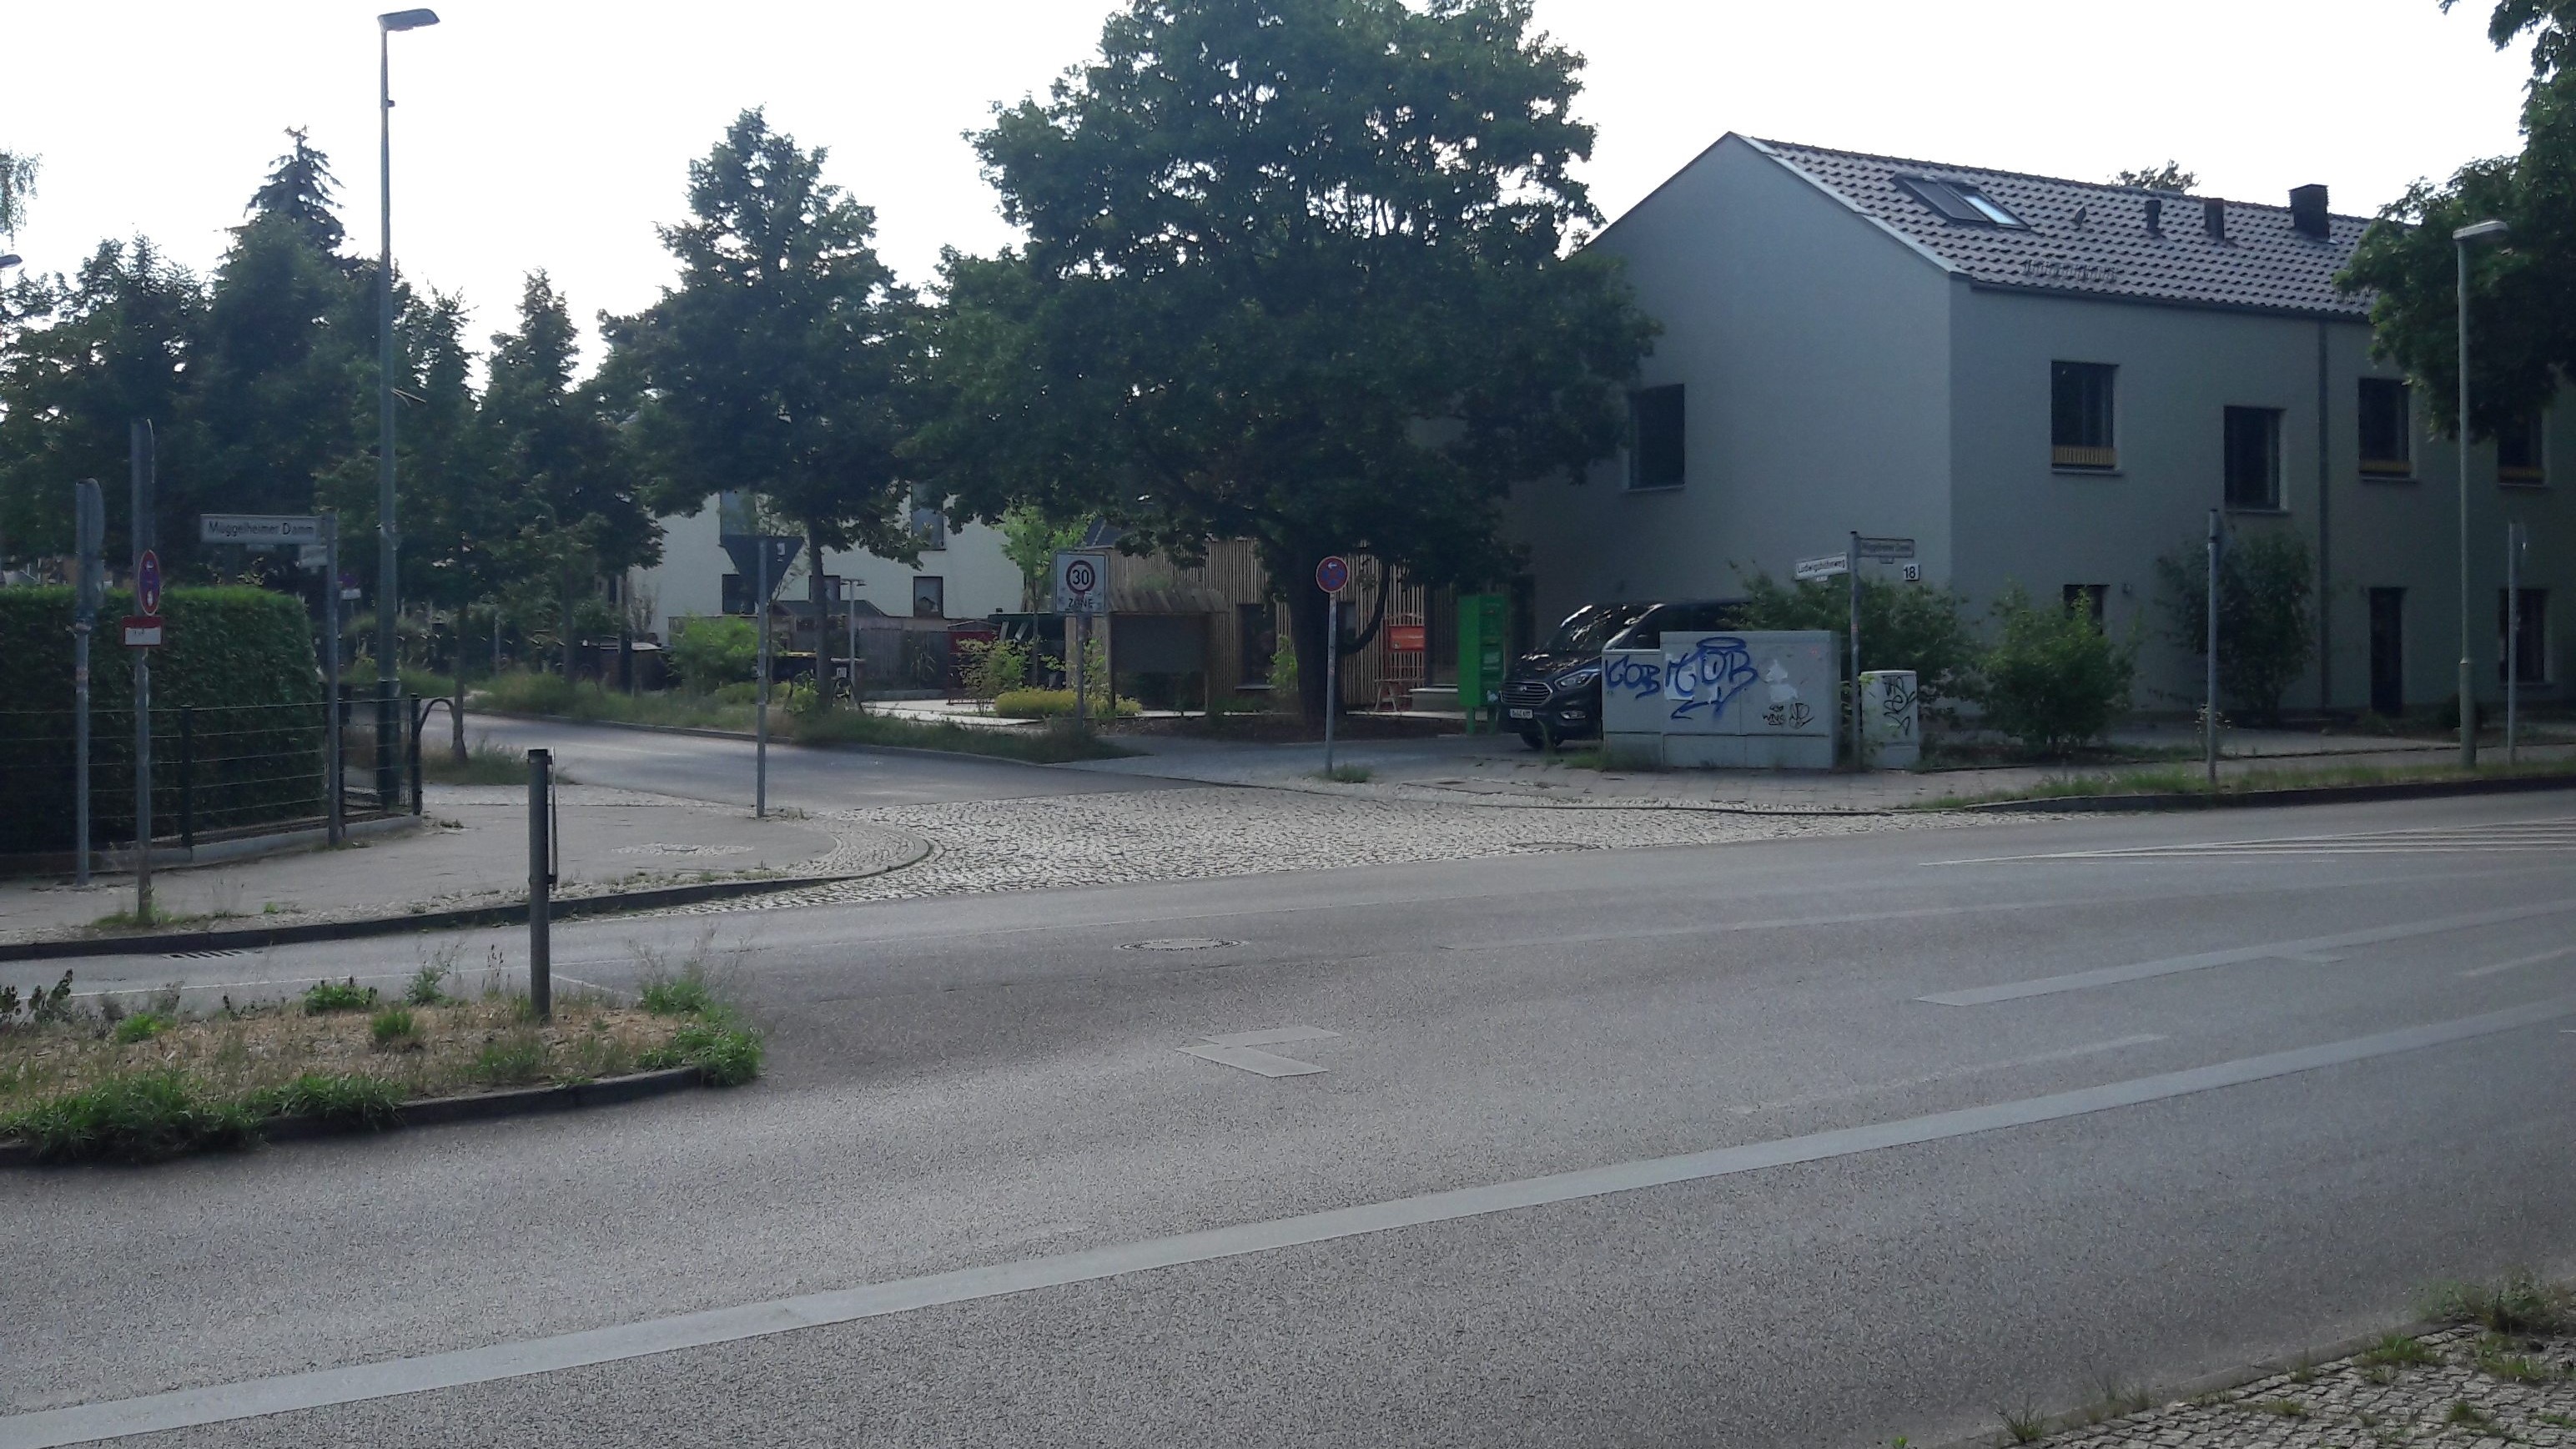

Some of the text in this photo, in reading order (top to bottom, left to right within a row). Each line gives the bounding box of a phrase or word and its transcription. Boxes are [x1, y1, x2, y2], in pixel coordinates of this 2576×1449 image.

[283, 521, 314, 536] Damm
[1072, 569, 1089, 585] 30
[1903, 566, 1916, 579] 18
[1068, 597, 1094, 608] ZONE
